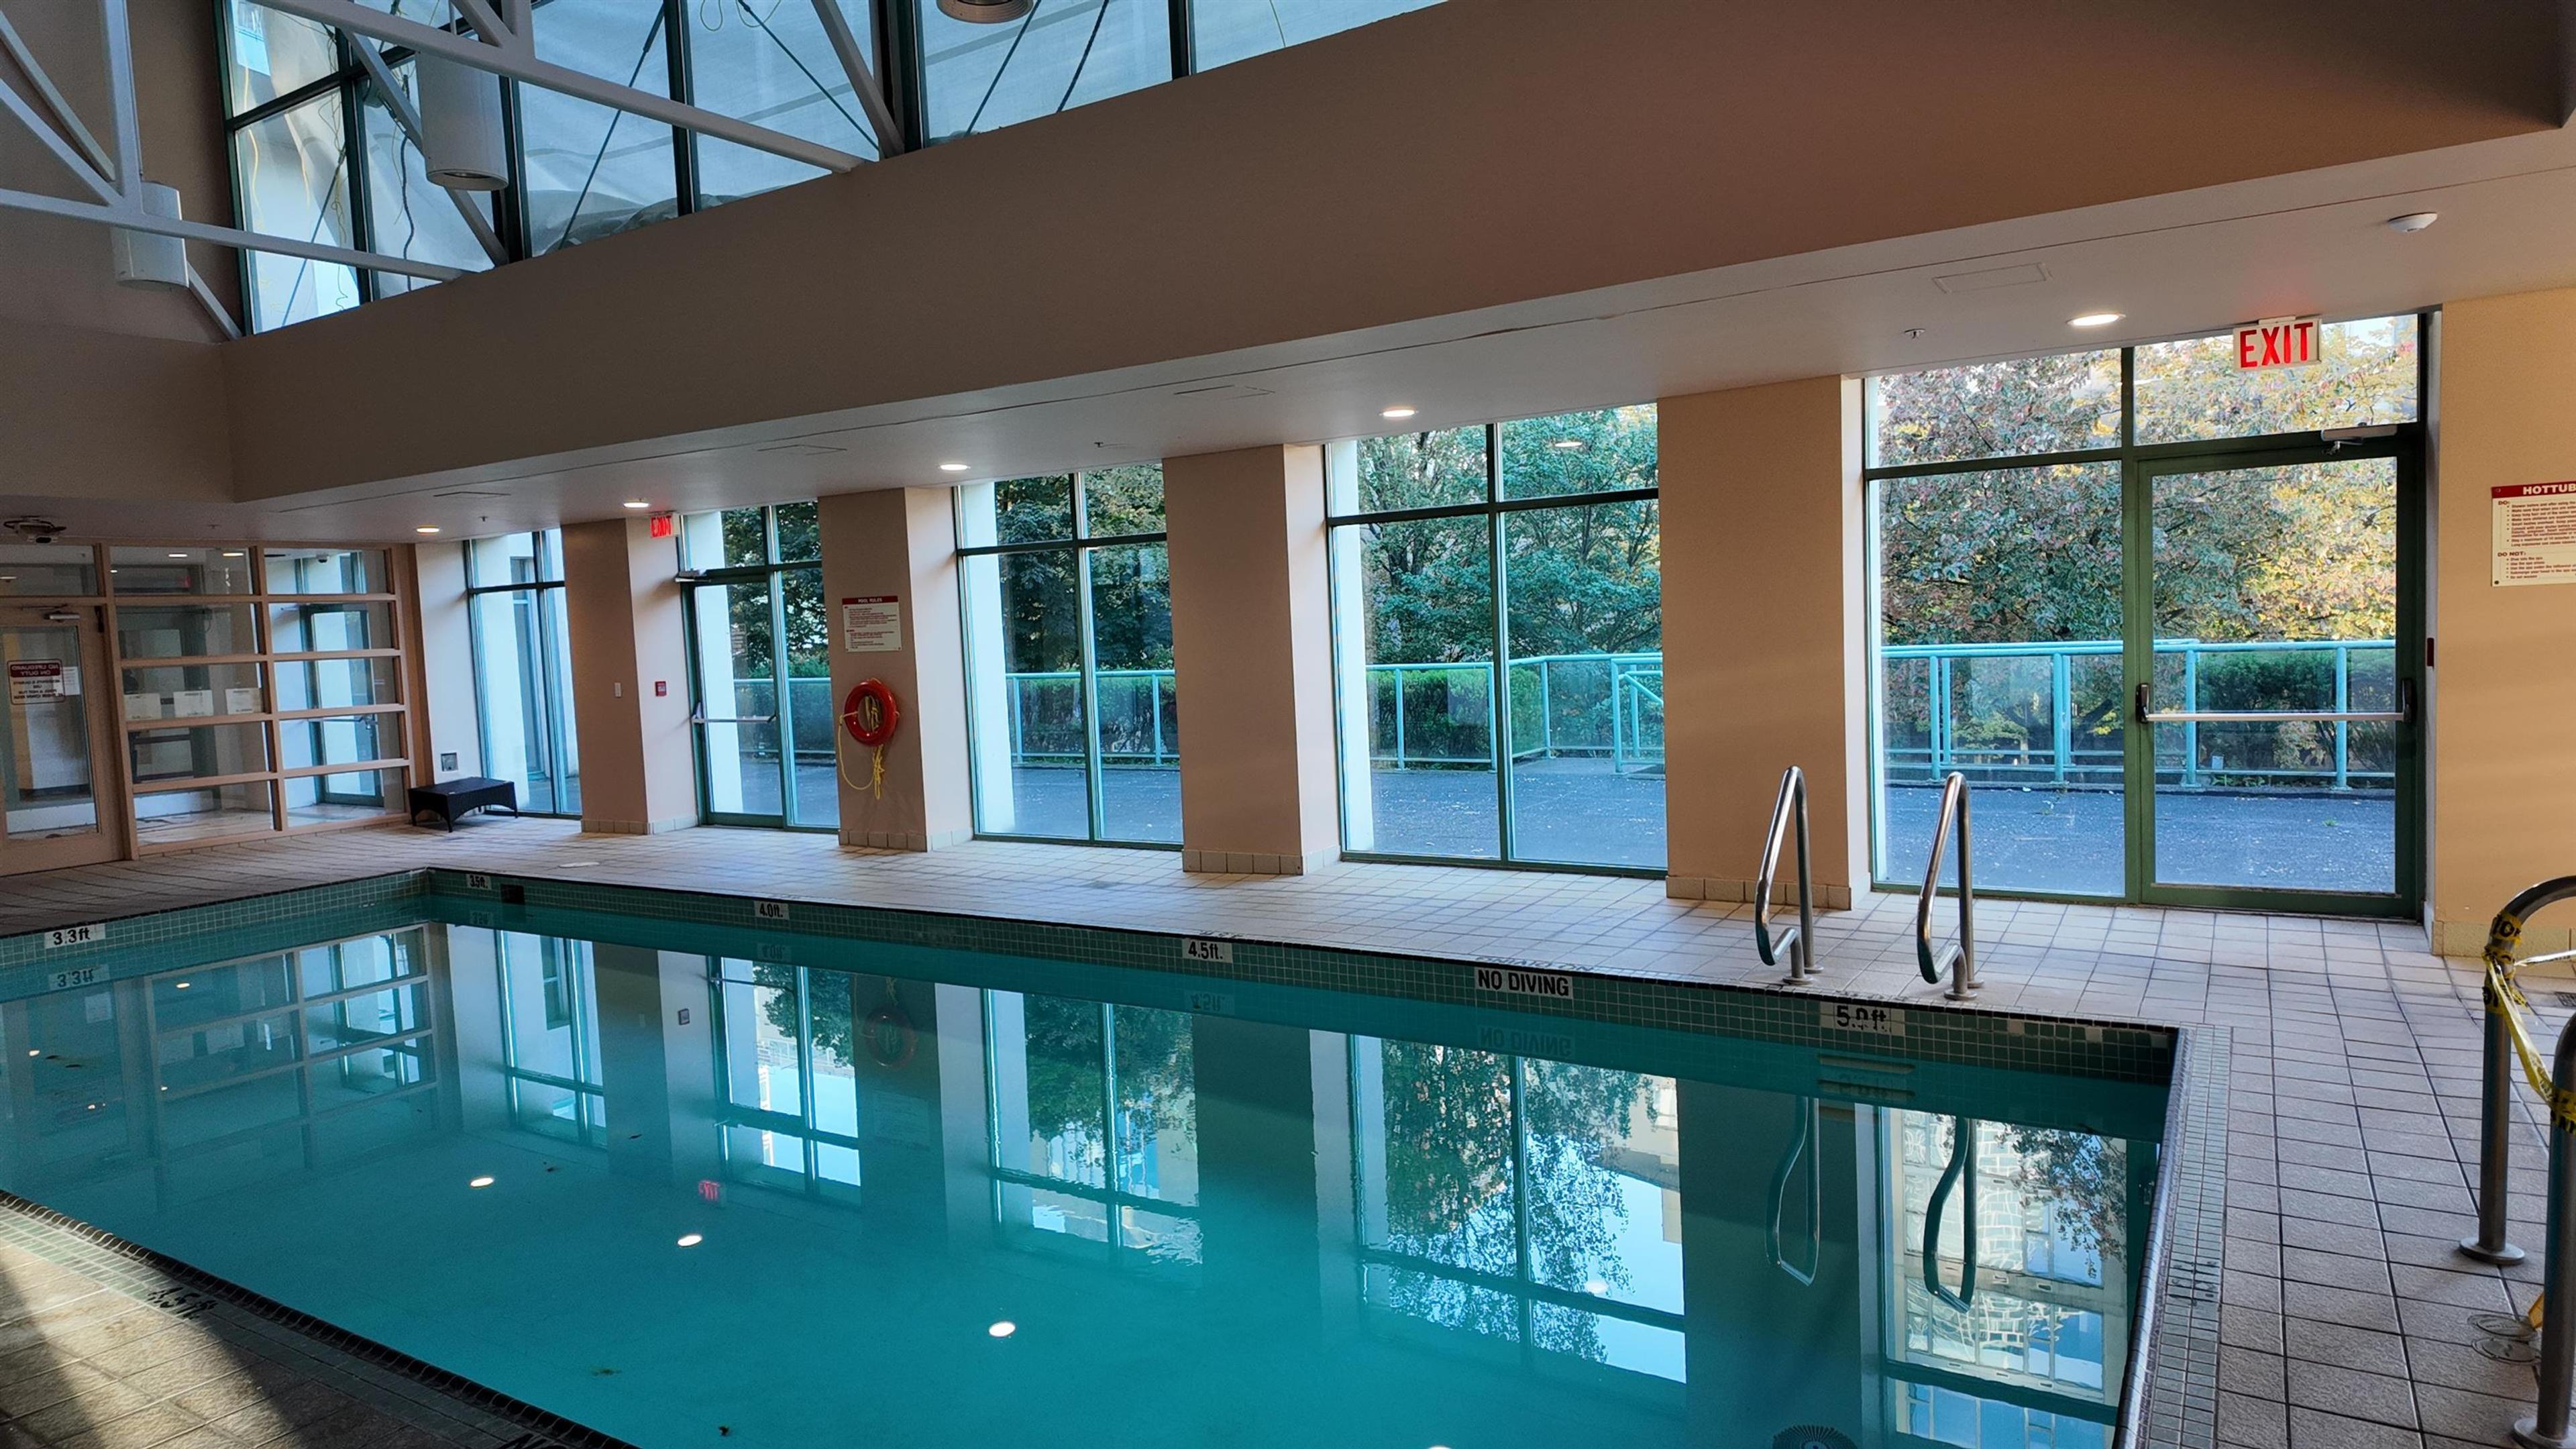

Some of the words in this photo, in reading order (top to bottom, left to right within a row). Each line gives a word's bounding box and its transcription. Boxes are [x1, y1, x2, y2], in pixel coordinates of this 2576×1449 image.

[2240, 322, 2313, 368] EXIT
[2522, 484, 2576, 495] HOTTUB
[53, 928, 91, 945] 3.3ft
[1188, 941, 1223, 959] 4.5ft.
[1479, 970, 1502, 990] NO
[1509, 973, 1568, 996] DIVING
